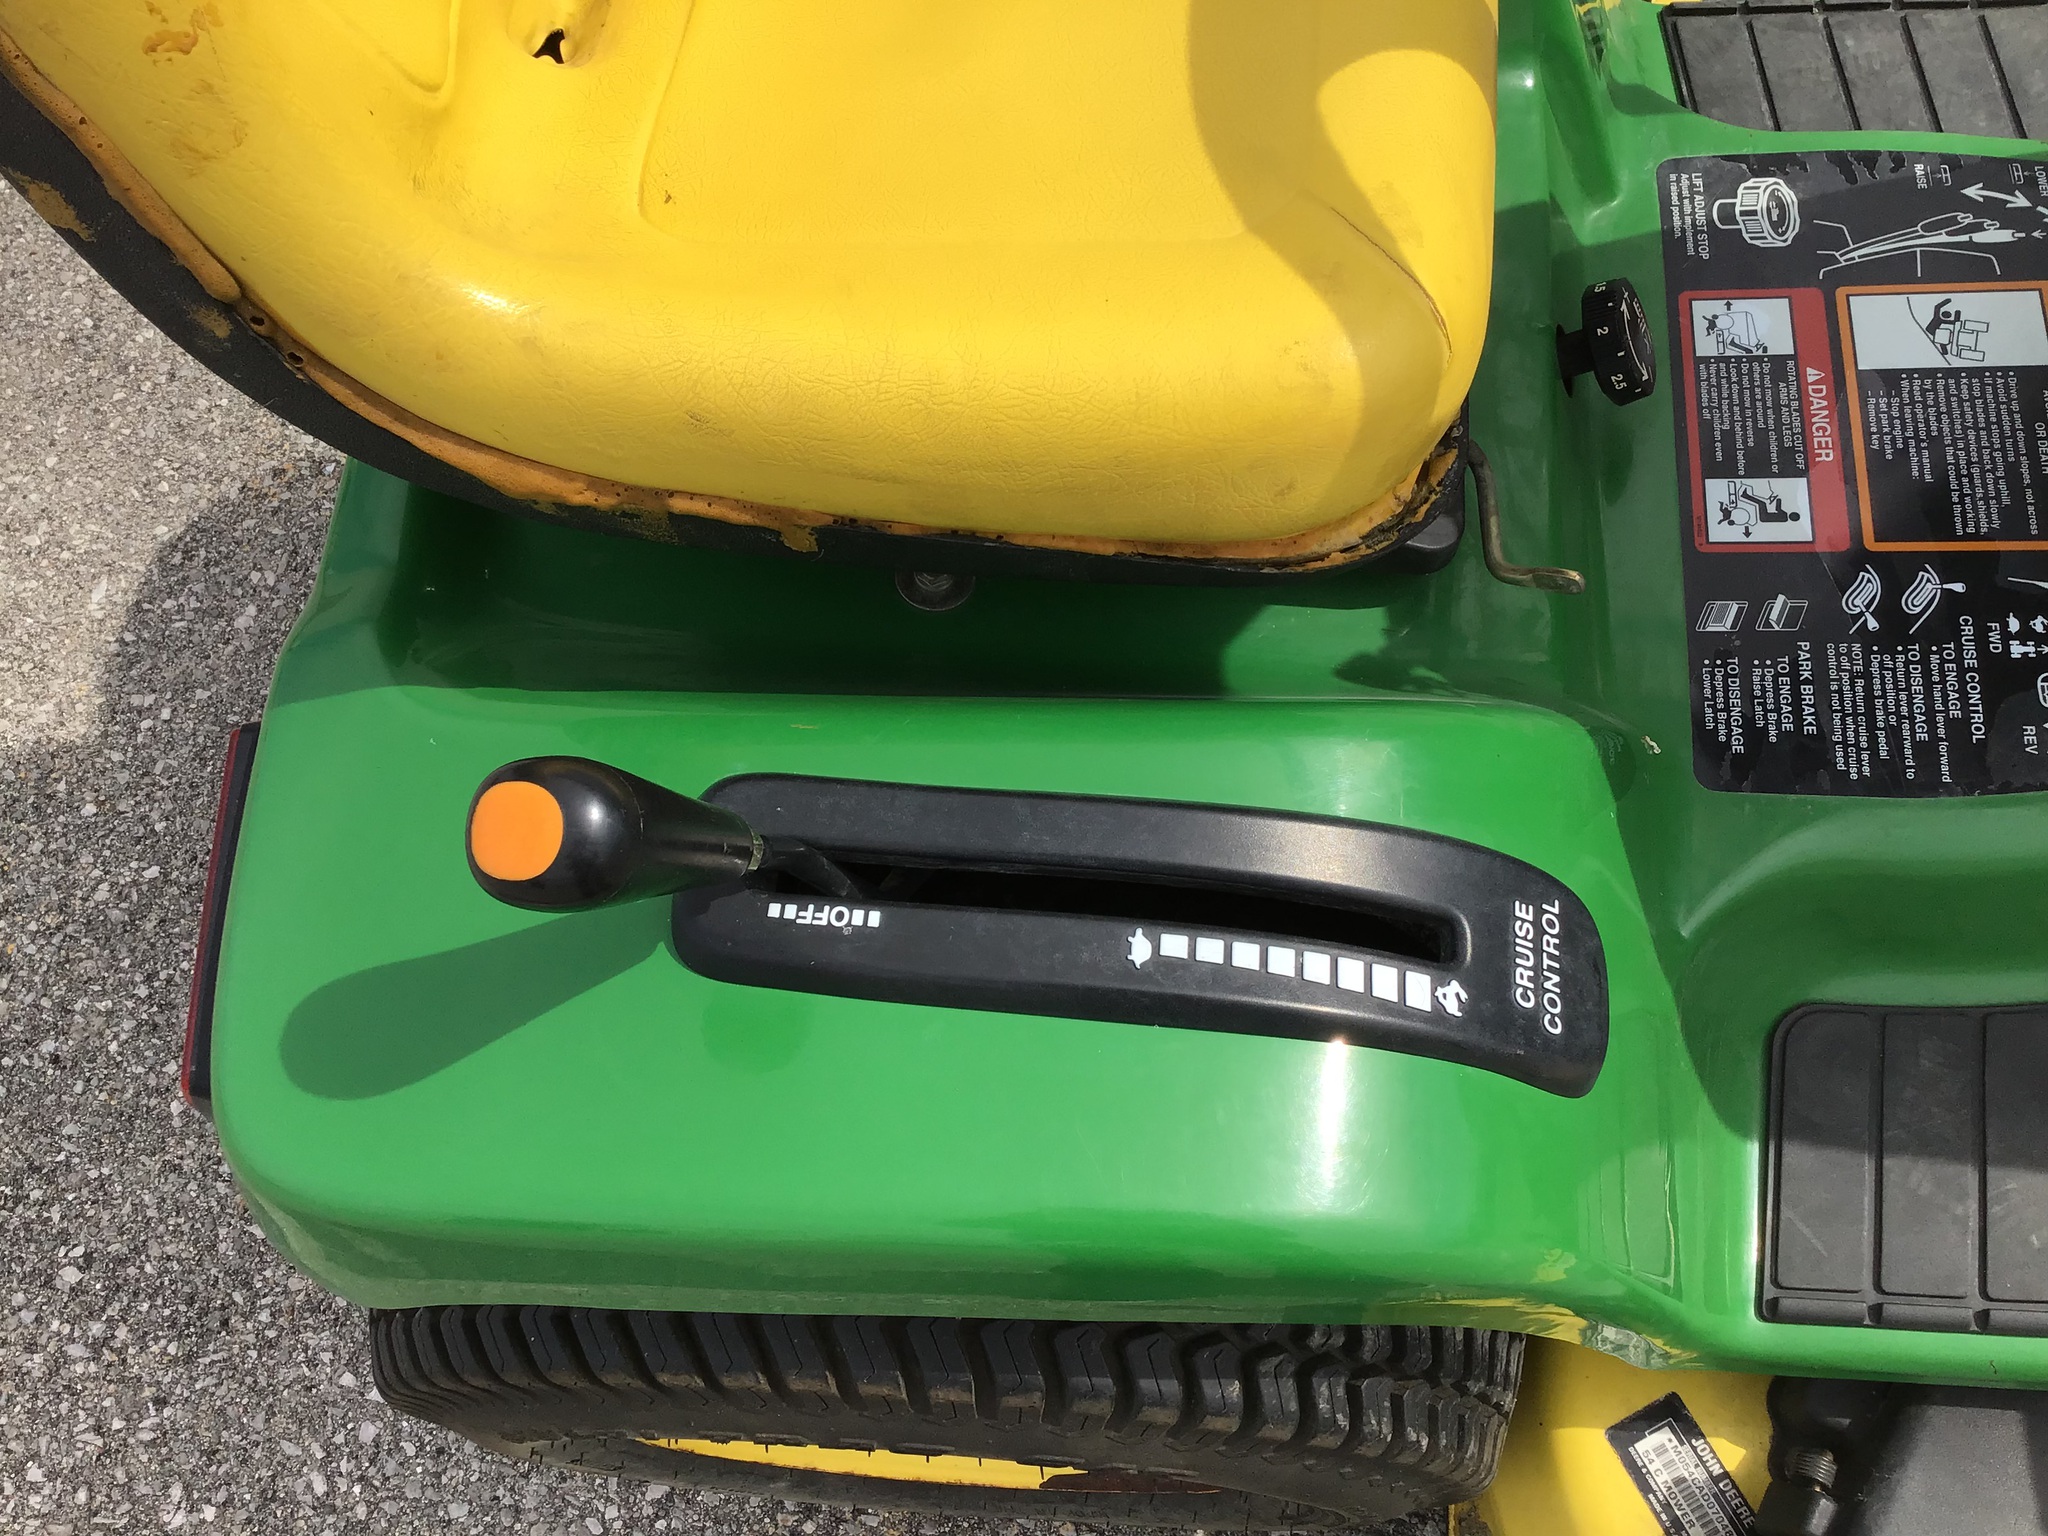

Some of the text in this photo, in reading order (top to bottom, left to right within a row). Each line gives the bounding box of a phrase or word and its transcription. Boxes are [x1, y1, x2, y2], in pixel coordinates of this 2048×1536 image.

[1671, 183, 1679, 204] raised
[1914, 164, 1927, 189] RAISE
[2035, 166, 2048, 196] LOWER
[1670, 207, 1682, 239] position.
[1680, 173, 1695, 255] Adjust with implement
[1692, 173, 1709, 259] LIFT ADJUST STOP
[1597, 327, 1608, 336] 2
[1611, 374, 1627, 390] 2.5
[1720, 363, 1730, 429] and while backing
[1752, 362, 1762, 385] others
[1763, 363, 1771, 373] Do
[1764, 375, 1772, 387] not
[1730, 364, 1746, 475] Look down and behind before
[1756, 401, 1765, 427] around
[1767, 409, 1775, 429] when
[1778, 382, 1791, 447] ARMS AND LEGS
[1787, 361, 1804, 470] ROTATING BLADES CUT OFF
[1808, 385, 1833, 461] DANGER
[1867, 398, 1880, 449] Remove key
[1879, 398, 1894, 459] Set park brake
[1890, 397, 1904, 448] Stop engine
[1901, 380, 1920, 479] When leaving machine:
[1912, 380, 1934, 482] Read operator's manual
[1923, 379, 1940, 436] by the blades
[1985, 386, 1998, 422] machine
[1991, 425, 2001, 448] stops
[1996, 378, 2015, 462] Avoid sudden turns
[2035, 423, 2046, 437] OR
[1769, 431, 1778, 462] children
[1771, 465, 1778, 473] or
[1936, 379, 1963, 535] Remove objects that could be thrown
[1972, 378, 2001, 528] stop blades and back down slowly
[1993, 451, 2006, 476] going
[2008, 378, 2038, 534] Drive up and down slopes, not across
[2037, 441, 2048, 474] DEATH
[1998, 479, 2011, 507] uphill,
[1987, 622, 2002, 653] FWD
[1703, 668, 1715, 730] Lower Latch
[1713, 668, 1728, 742] Depress Brake
[1727, 657, 1744, 754] TO DISENGAGE
[1752, 669, 1766, 727] Raise Latch
[1763, 669, 1778, 743] Depress Brake
[1777, 656, 1793, 732] TO ENGAGE
[1797, 642, 1816, 735] PARK BRAKE
[1827, 643, 1846, 770] control is not being used
[1839, 643, 1859, 780] to off position when cruise
[1851, 644, 1871, 777] NOTE: Return cruise lever
[1869, 654, 1890, 759] Depress brake pedal
[1882, 654, 1897, 726] off position or
[1907, 644, 1928, 741] TO DISENGAGE
[1943, 642, 1961, 718] TO ENGAGE
[1959, 615, 1985, 743] CRUISE CONTROL
[1895, 654, 1916, 779] Return lever rearward to
[1930, 654, 1952, 782] Move hand lever forward
[2022, 725, 2038, 754] REV
[796, 904, 849, 927] OFF
[1515, 901, 1535, 1008] CRUISE
[1541, 900, 1562, 1034] CONTROL
[1642, 1450, 1655, 1465] 54
[1654, 1468, 1663, 1477] C
[1661, 1480, 1695, 1529] MOWER
[1648, 1494, 1662, 1514] MADE
[1691, 1438, 1755, 1528] JOHN DEERE
